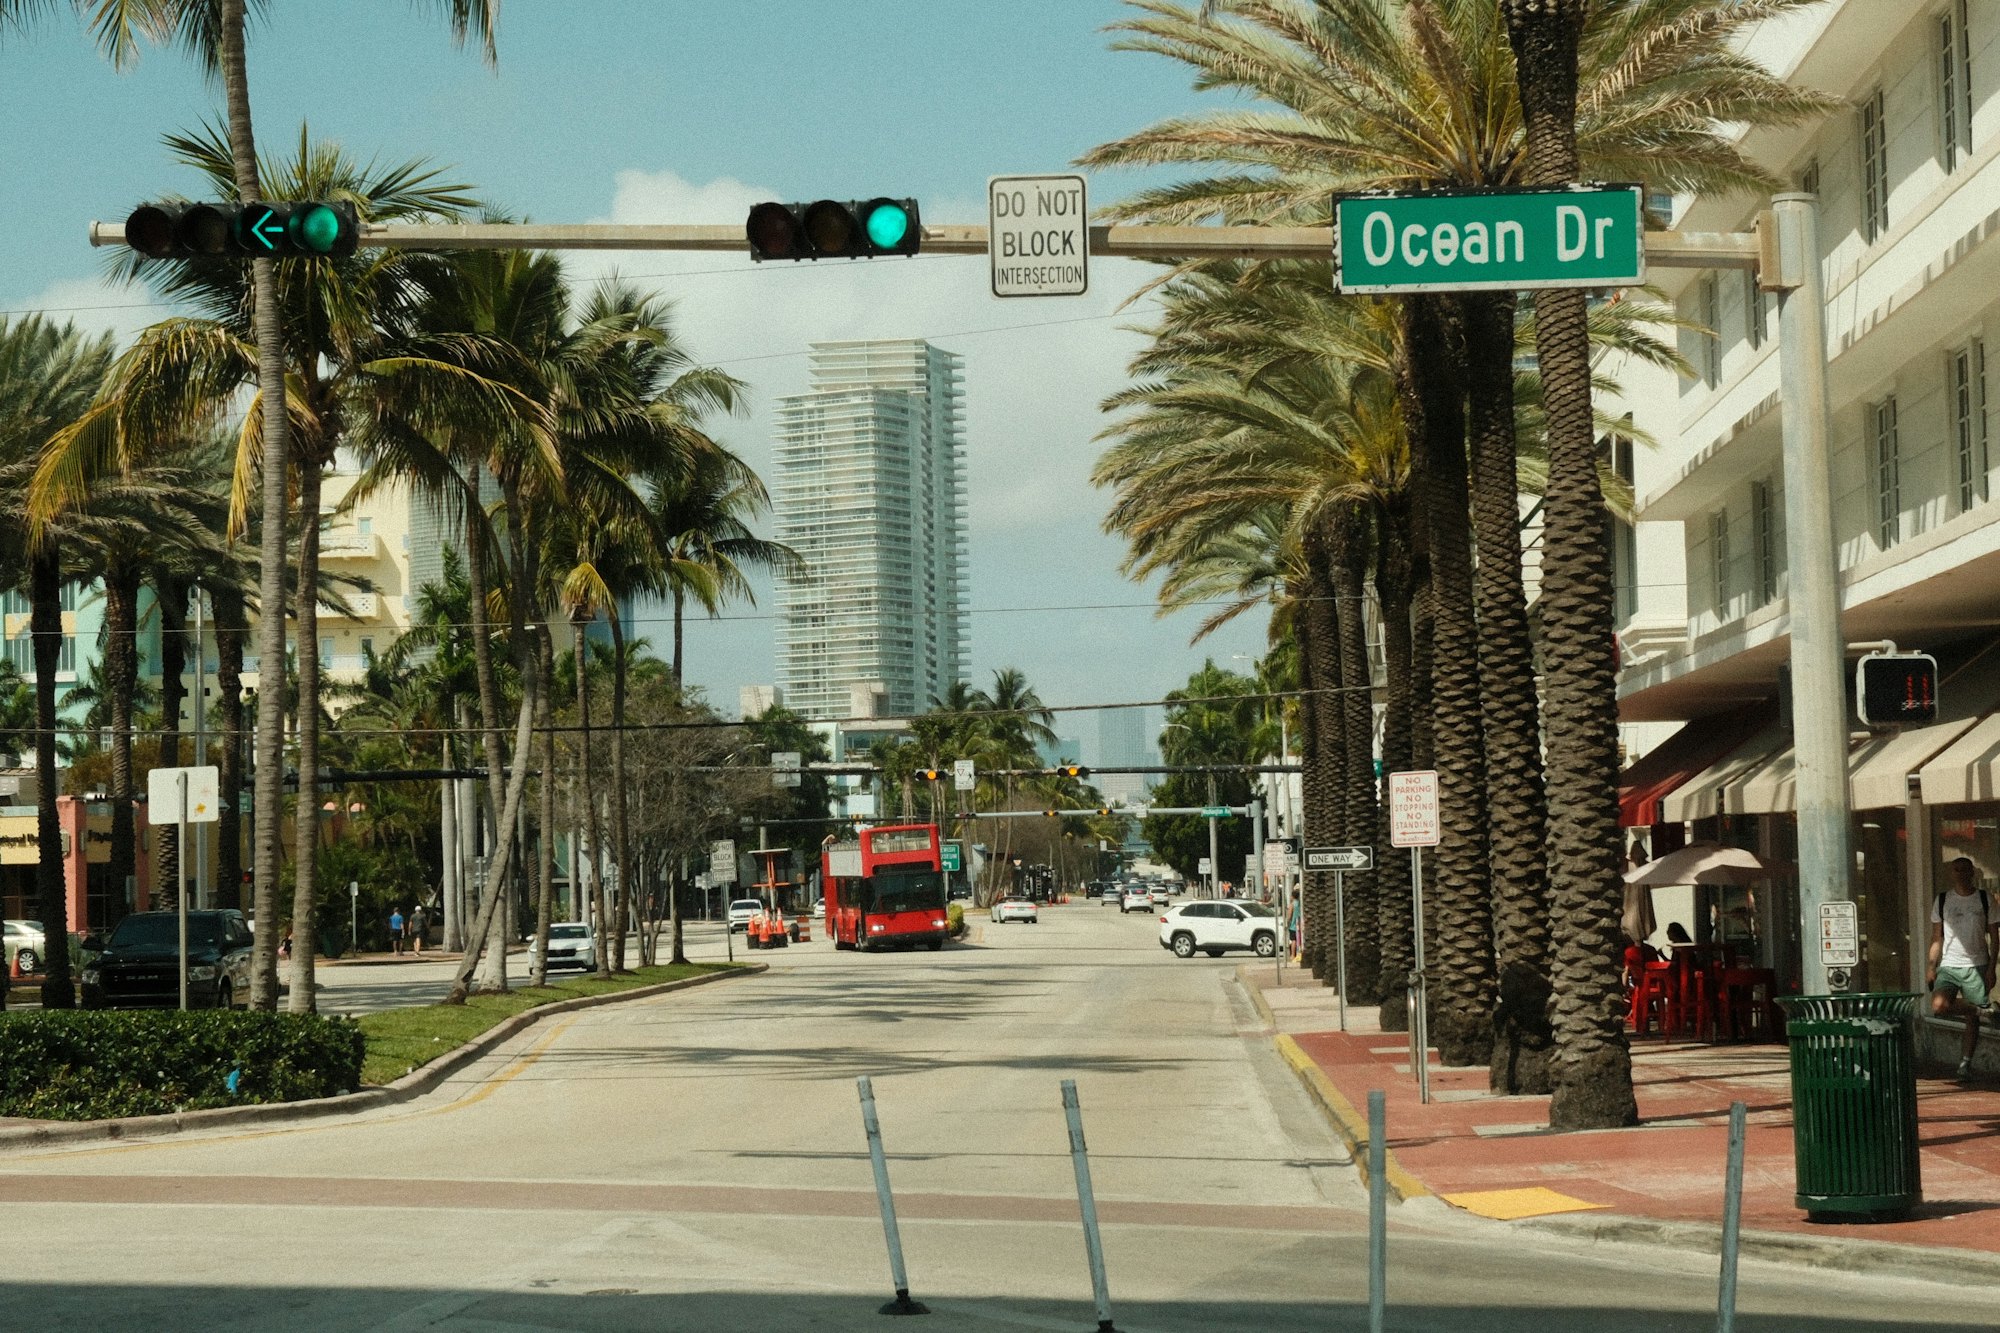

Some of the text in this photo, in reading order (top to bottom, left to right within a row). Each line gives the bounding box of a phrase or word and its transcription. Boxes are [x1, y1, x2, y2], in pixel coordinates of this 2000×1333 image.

[996, 189, 1079, 217] DO NOT
[1362, 205, 1614, 267] Ocean Dr
[1002, 230, 1075, 257] BLOCK
[997, 265, 1082, 285] INTERSECTION
[1395, 786, 1432, 794] PARKING
[1395, 803, 1434, 812] STOPPING
[1406, 812, 1422, 820] NO
[1395, 821, 1434, 830] STANDING
[1311, 854, 1351, 864] ONE WAY
